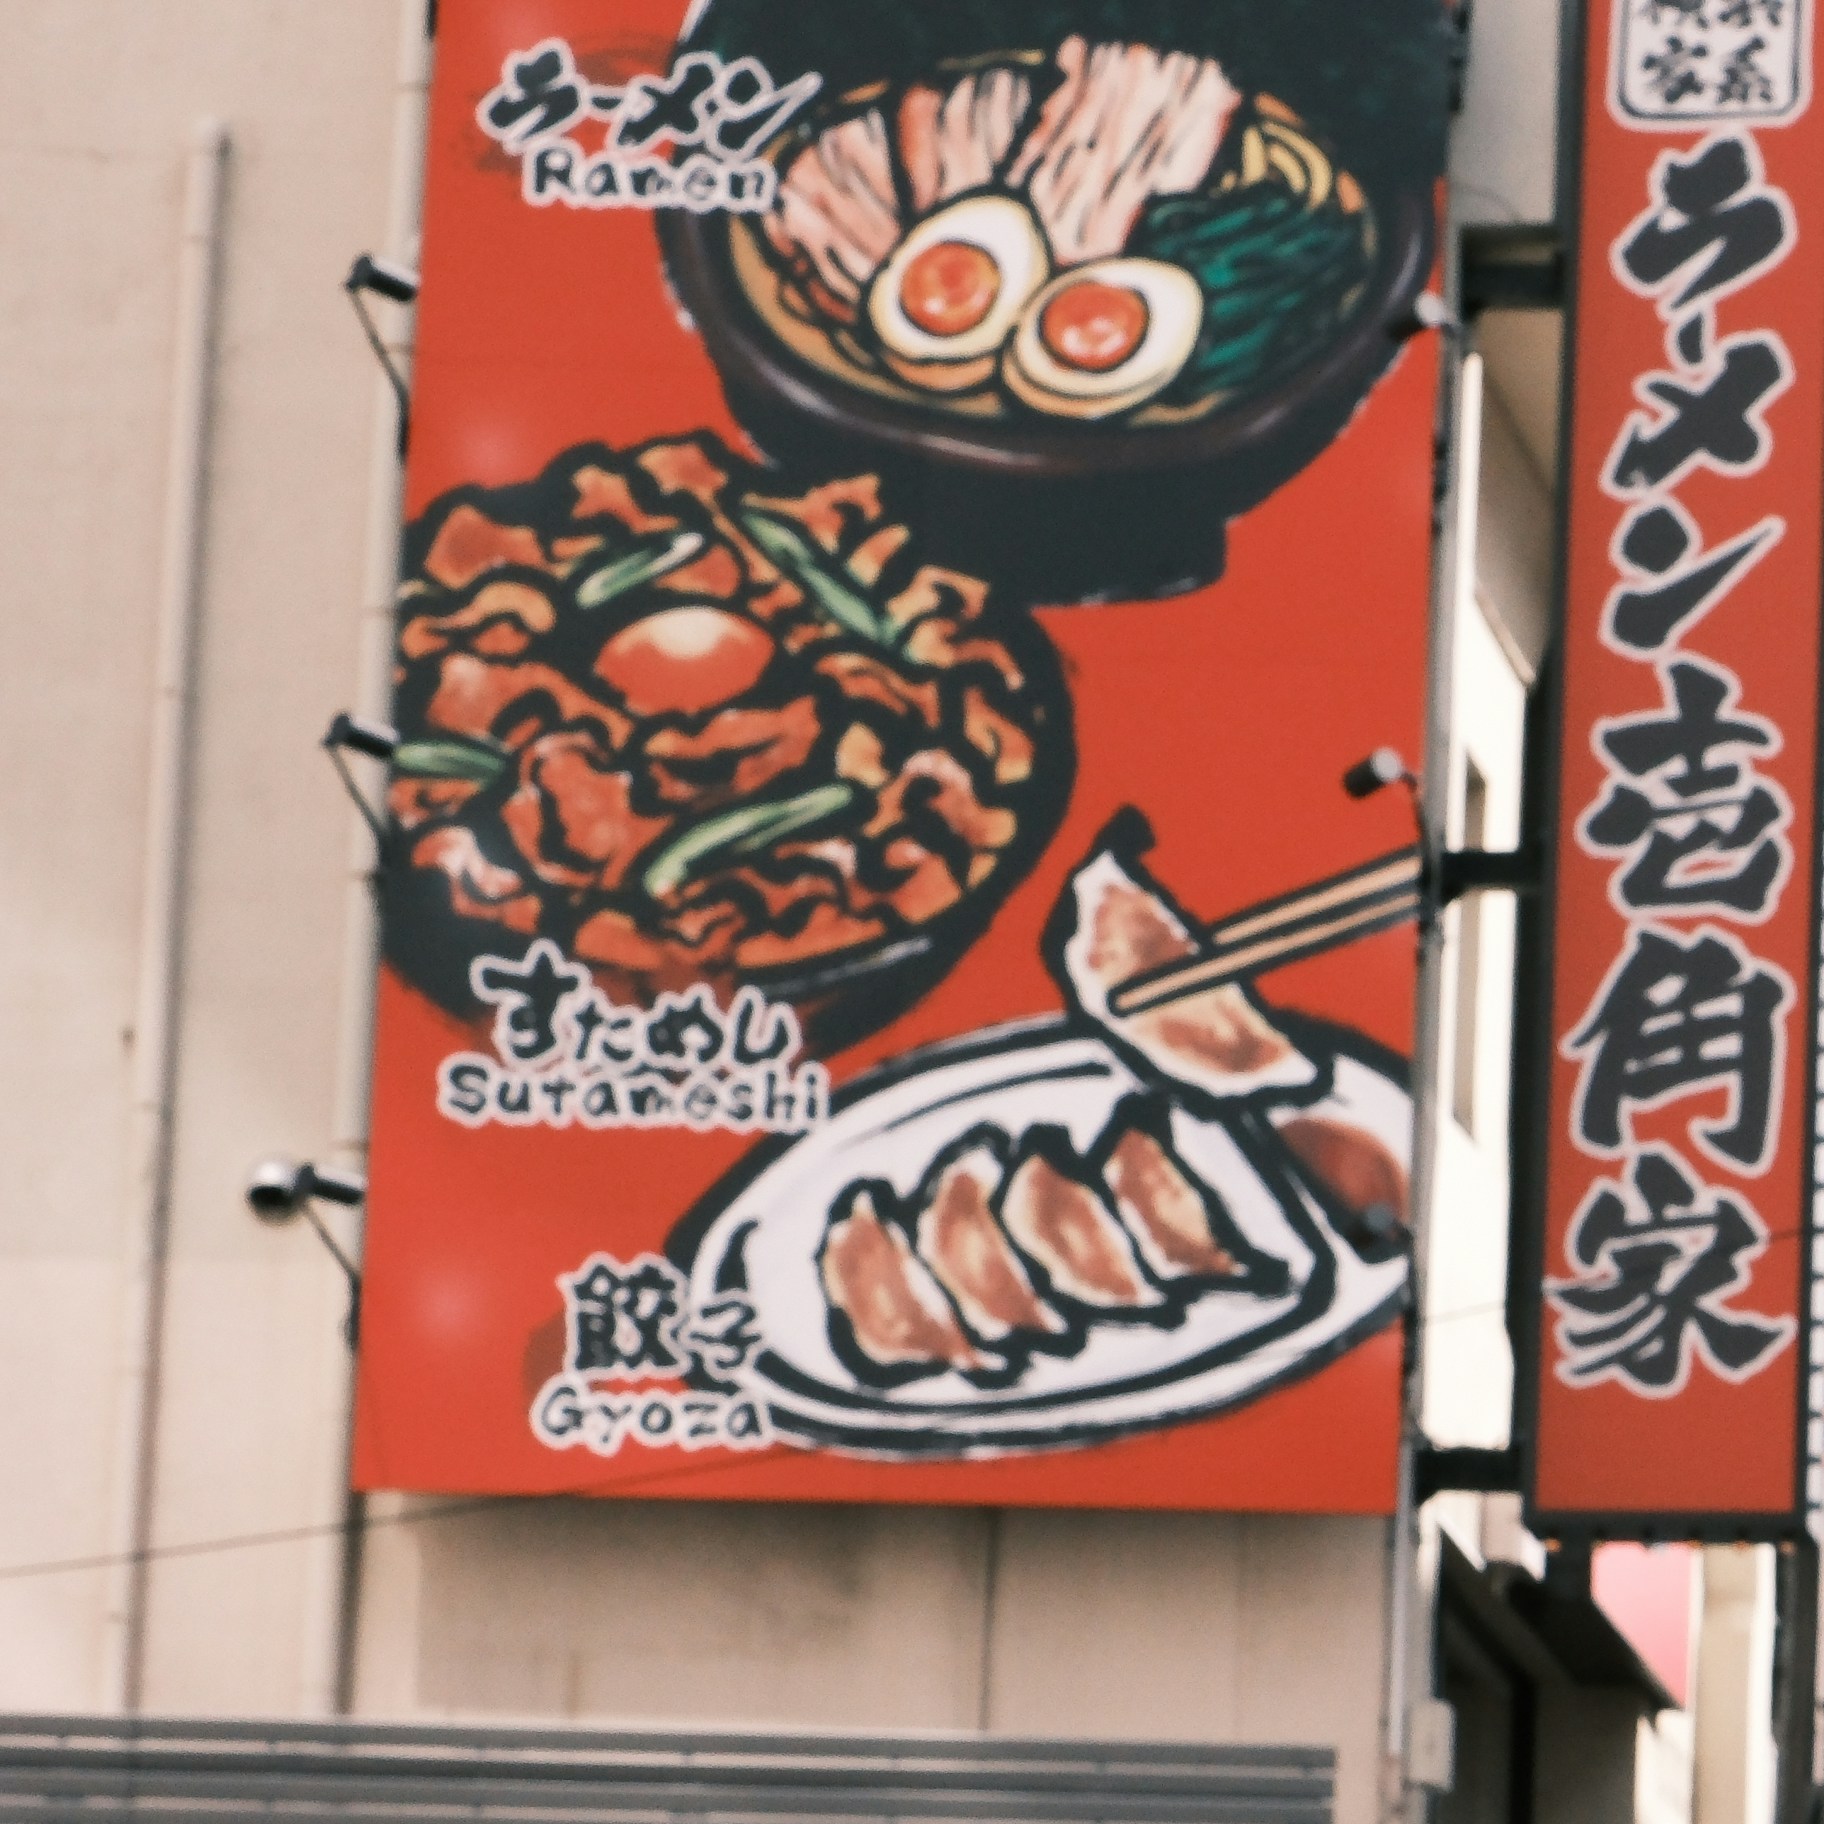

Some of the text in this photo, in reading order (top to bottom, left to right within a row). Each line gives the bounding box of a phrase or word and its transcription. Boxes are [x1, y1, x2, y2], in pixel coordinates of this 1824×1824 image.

[480, 42, 820, 154] ラーメン
[531, 149, 774, 205] Ramen
[482, 951, 790, 1065] すためし
[574, 1262, 762, 1370] 餃子
[540, 1384, 763, 1444] Gyoza
